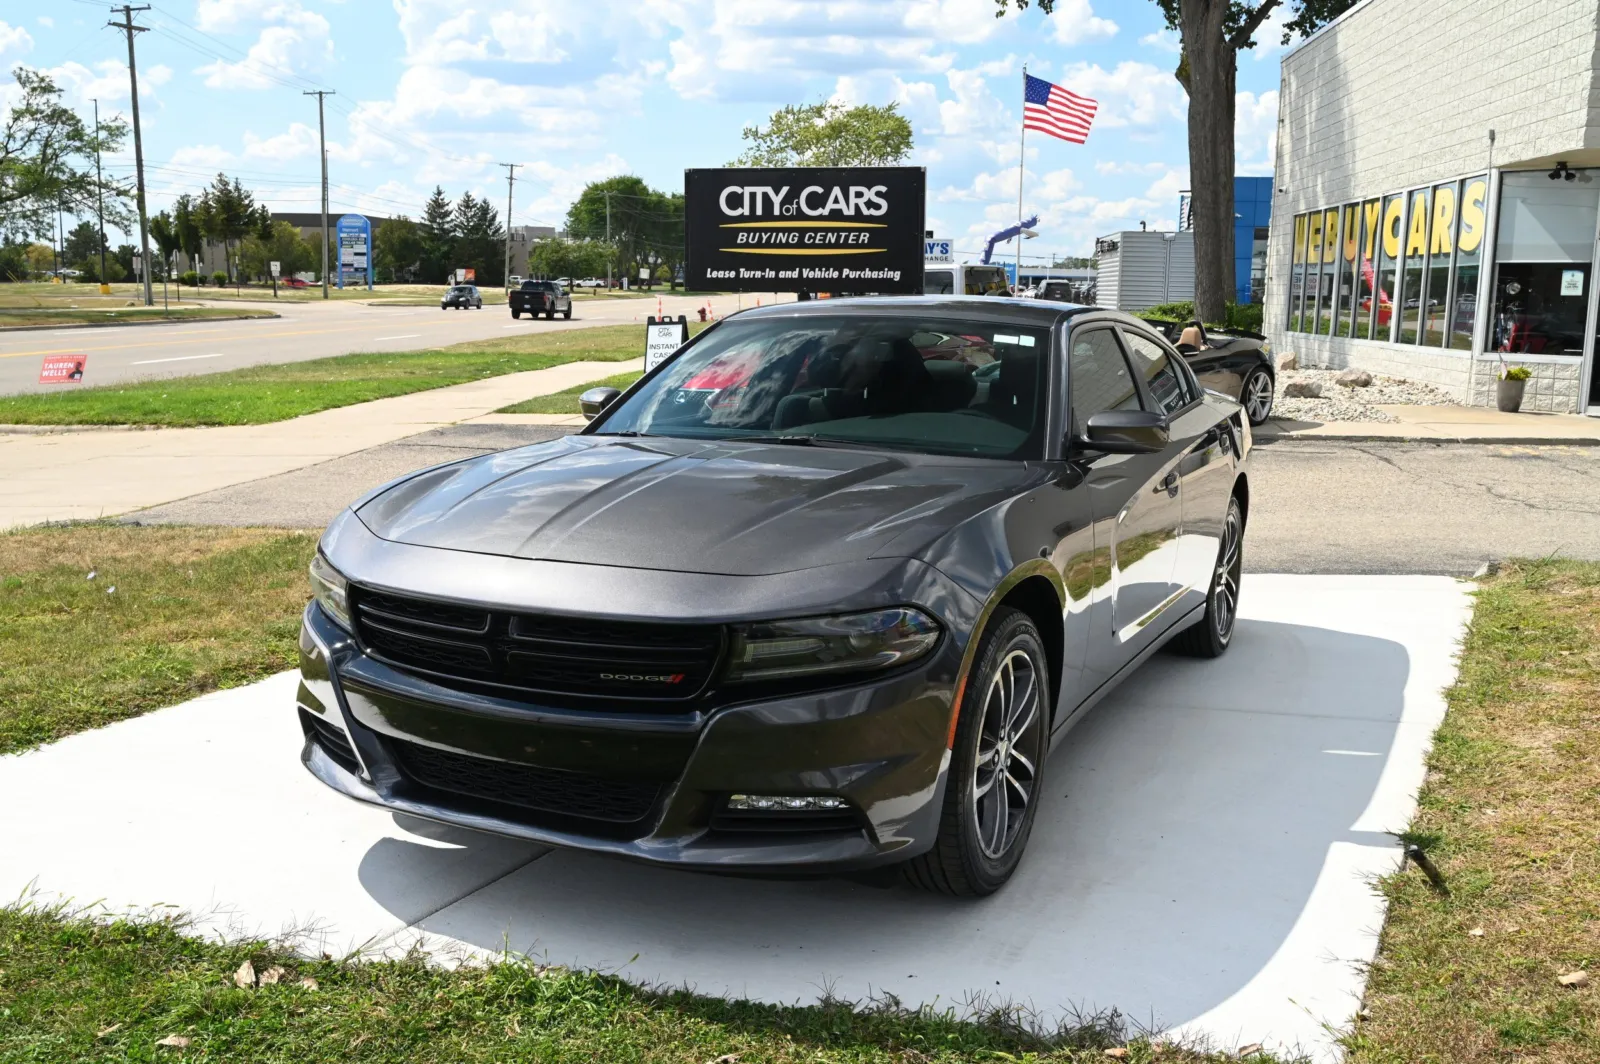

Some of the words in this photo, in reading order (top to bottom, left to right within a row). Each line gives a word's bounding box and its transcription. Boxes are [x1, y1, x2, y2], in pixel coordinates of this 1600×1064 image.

[719, 185, 790, 217] CITY
[782, 199, 799, 216] of
[800, 185, 889, 216] CARS
[1294, 213, 1321, 264] WE
[1323, 201, 1380, 262] BUY
[1383, 181, 1486, 257] CARS
[737, 232, 799, 244] BUYING
[804, 232, 870, 244] CENTER
[706, 268, 736, 278] Lease
[740, 268, 775, 278] Turn-In
[779, 268, 799, 278] and
[802, 268, 839, 278] Vehicle
[842, 268, 901, 281] Purchasing
[42, 369, 67, 377] WELLS
[600, 673, 673, 682] DODGE
